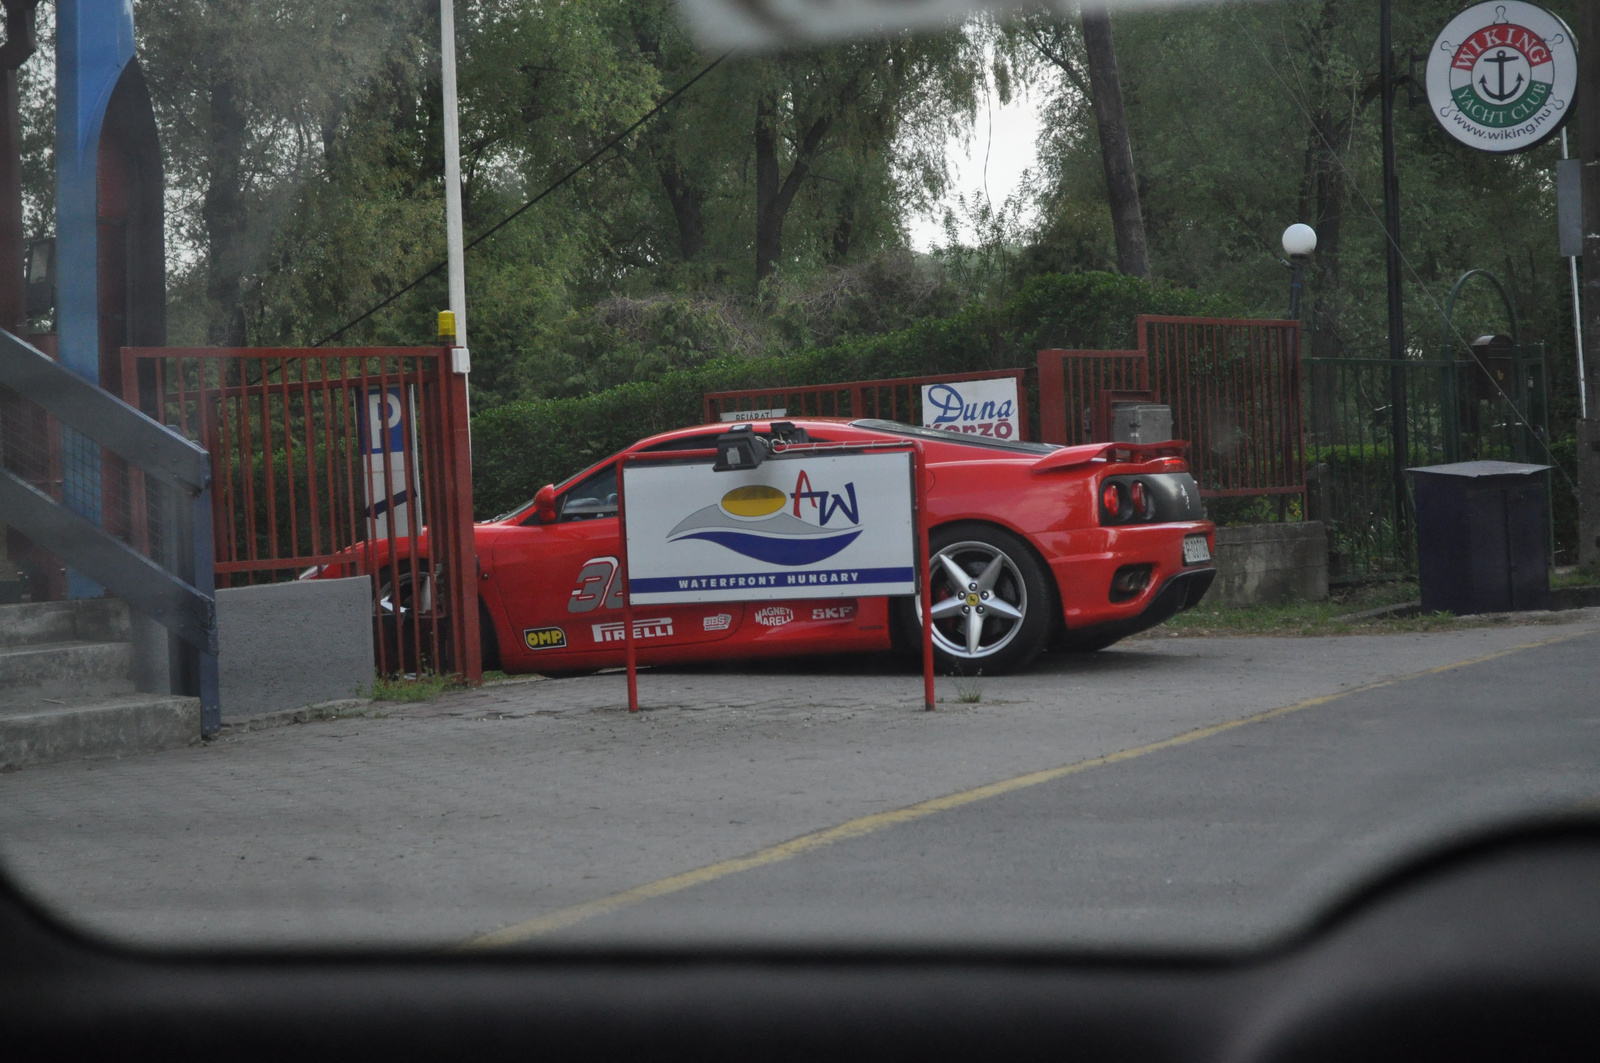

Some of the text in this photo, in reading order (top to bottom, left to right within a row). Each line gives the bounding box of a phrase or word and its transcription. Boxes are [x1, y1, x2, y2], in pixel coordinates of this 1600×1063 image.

[1455, 28, 1547, 67] WIKING
[1458, 83, 1547, 123] YACHT CLUB
[1453, 108, 1552, 140] www.wiking.hu
[928, 384, 1015, 425] Duna
[368, 393, 402, 450] P
[678, 572, 859, 589] WATERFRONT HUNGARY
[704, 617, 726, 626] BBS
[755, 606, 794, 622] MAGNETI
[755, 611, 794, 627] MARELLI
[812, 606, 853, 620] SKF
[526, 630, 563, 646] OMP
[591, 617, 674, 643] PIRELLI
